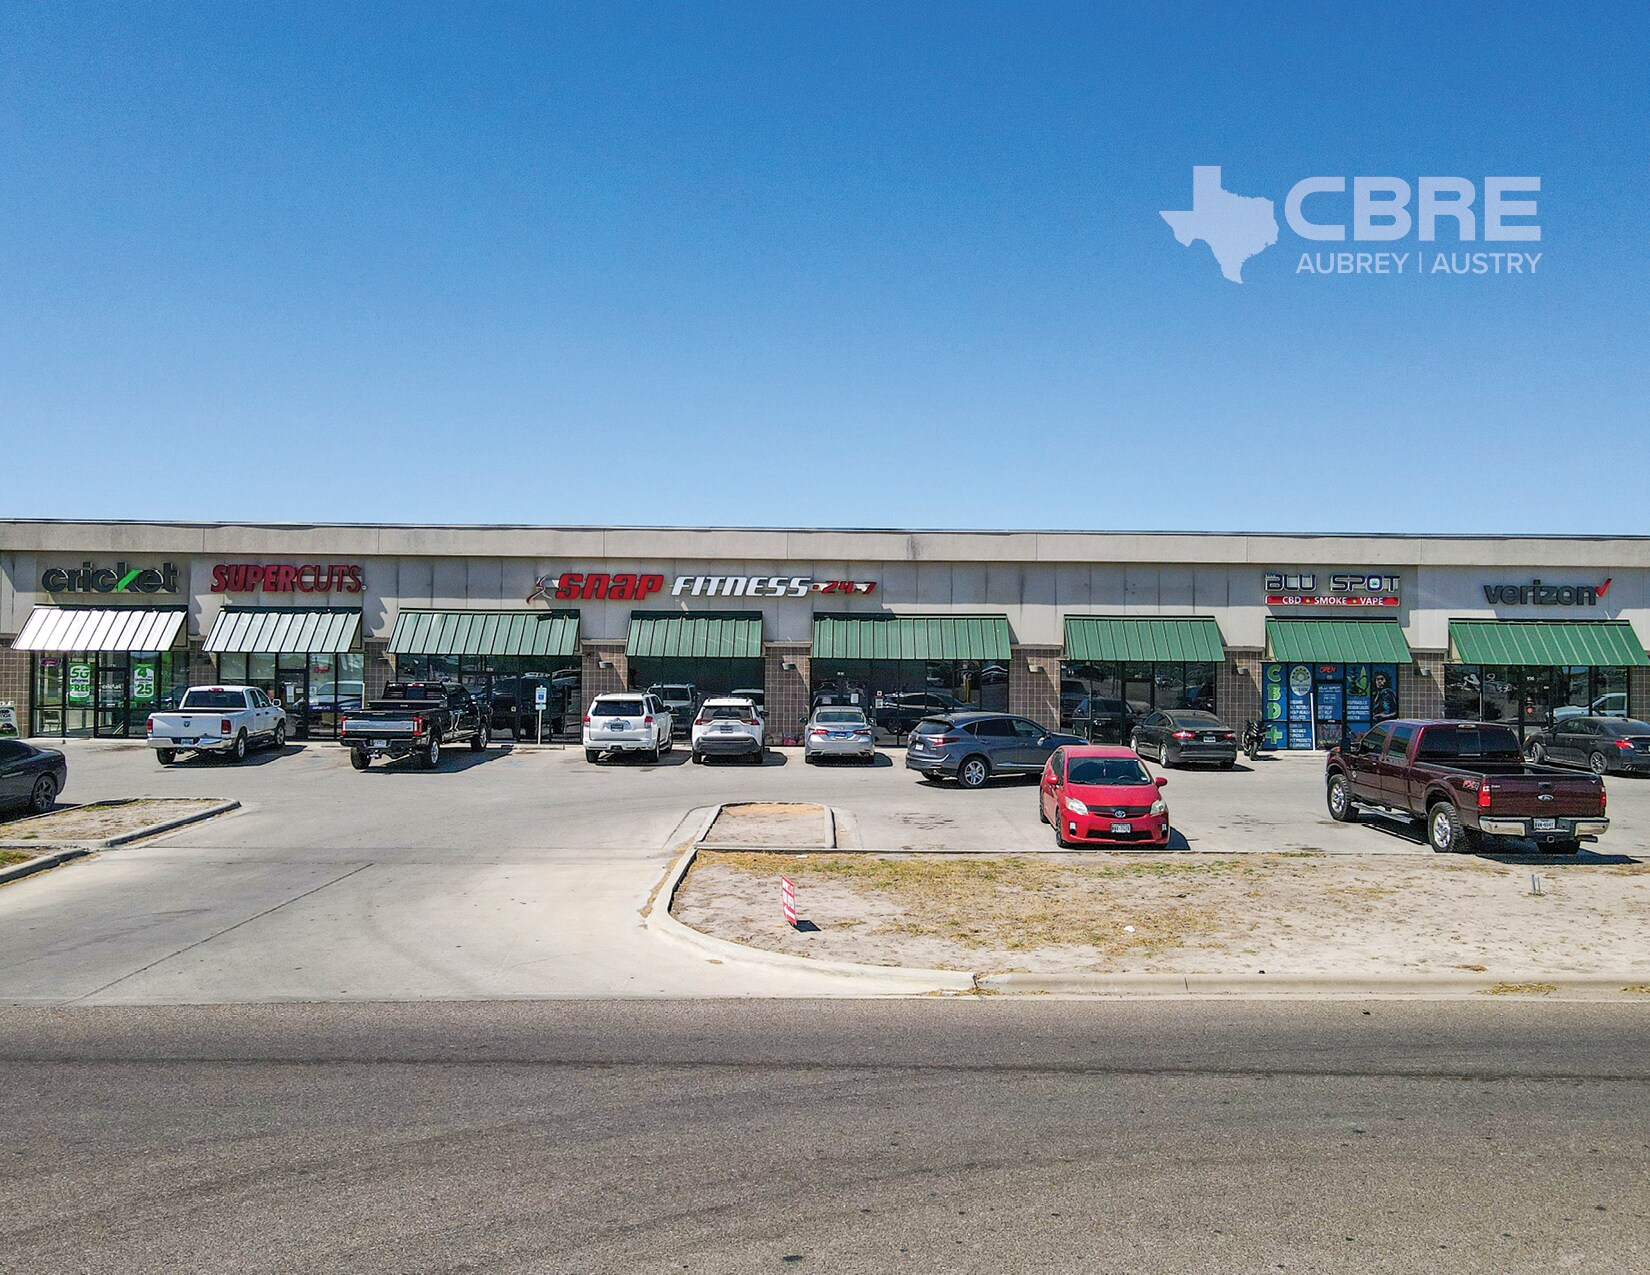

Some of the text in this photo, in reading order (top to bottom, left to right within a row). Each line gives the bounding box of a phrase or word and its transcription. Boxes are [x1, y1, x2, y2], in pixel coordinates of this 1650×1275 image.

[41, 561, 180, 593] cricket
[210, 564, 362, 593] SUPERCUTS
[1265, 574, 1400, 592] BLU SPOT
[1282, 596, 1384, 605] CBD SMOKE VAPE
[1483, 579, 1597, 606] verizon
[70, 684, 91, 692] FREE
[136, 684, 153, 695] 25
